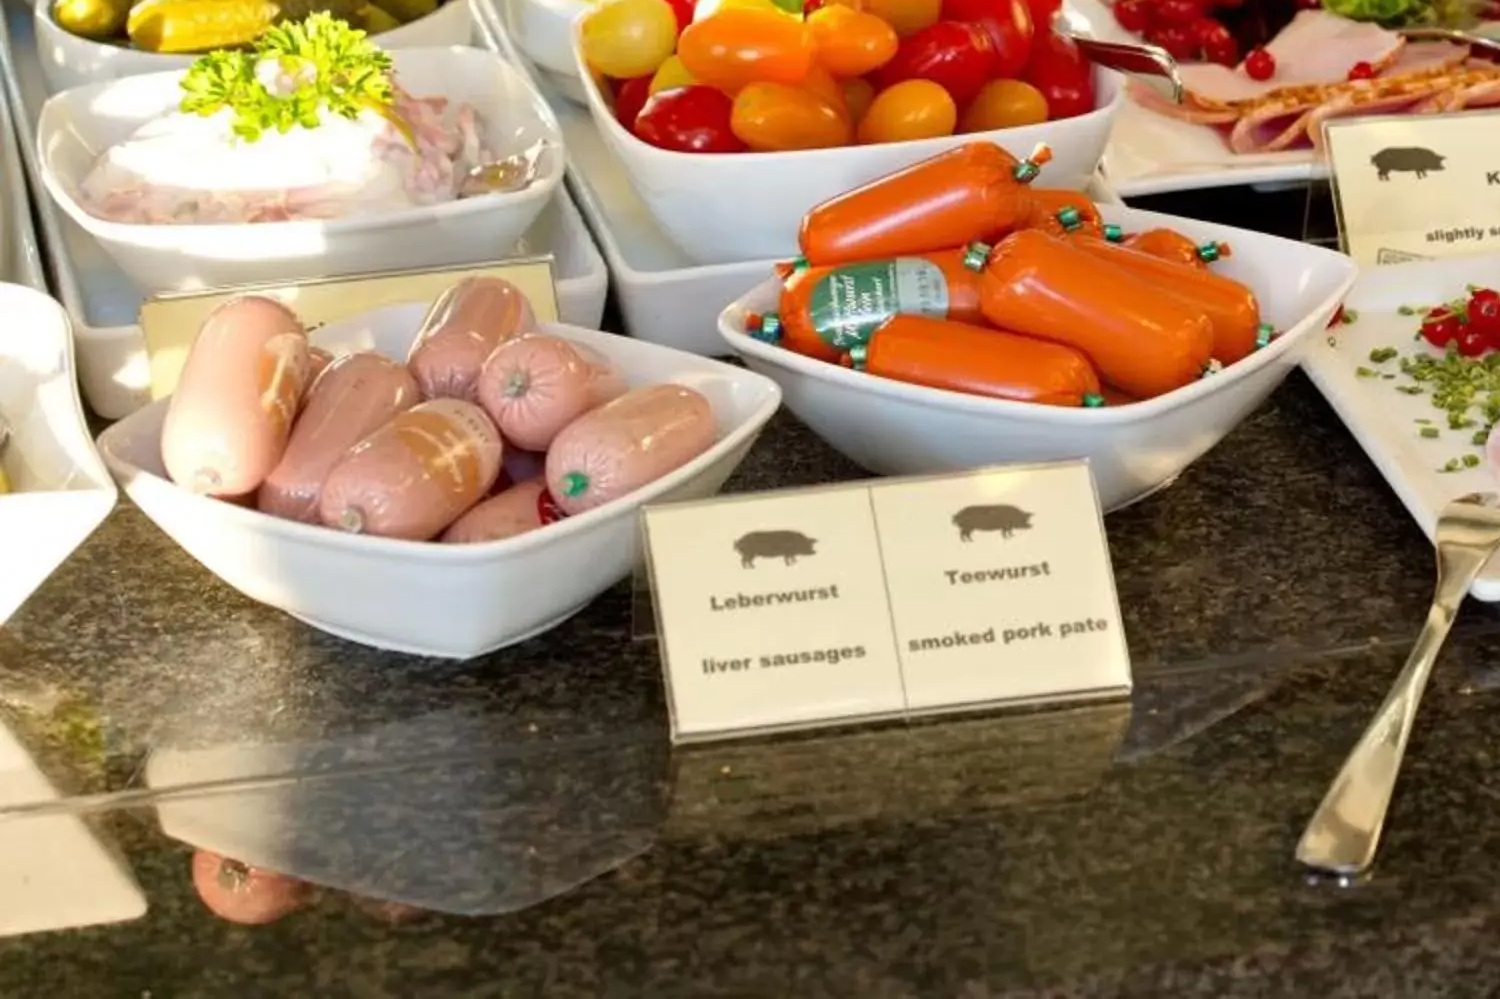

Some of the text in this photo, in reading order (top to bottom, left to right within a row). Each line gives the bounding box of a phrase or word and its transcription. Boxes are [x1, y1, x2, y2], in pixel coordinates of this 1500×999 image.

[1425, 226, 1485, 244] slightly
[943, 561, 1051, 586] Teewurst
[709, 584, 840, 612] Leberwurst
[908, 617, 1108, 652] smoked pork pate
[701, 645, 867, 674] liver sausages
